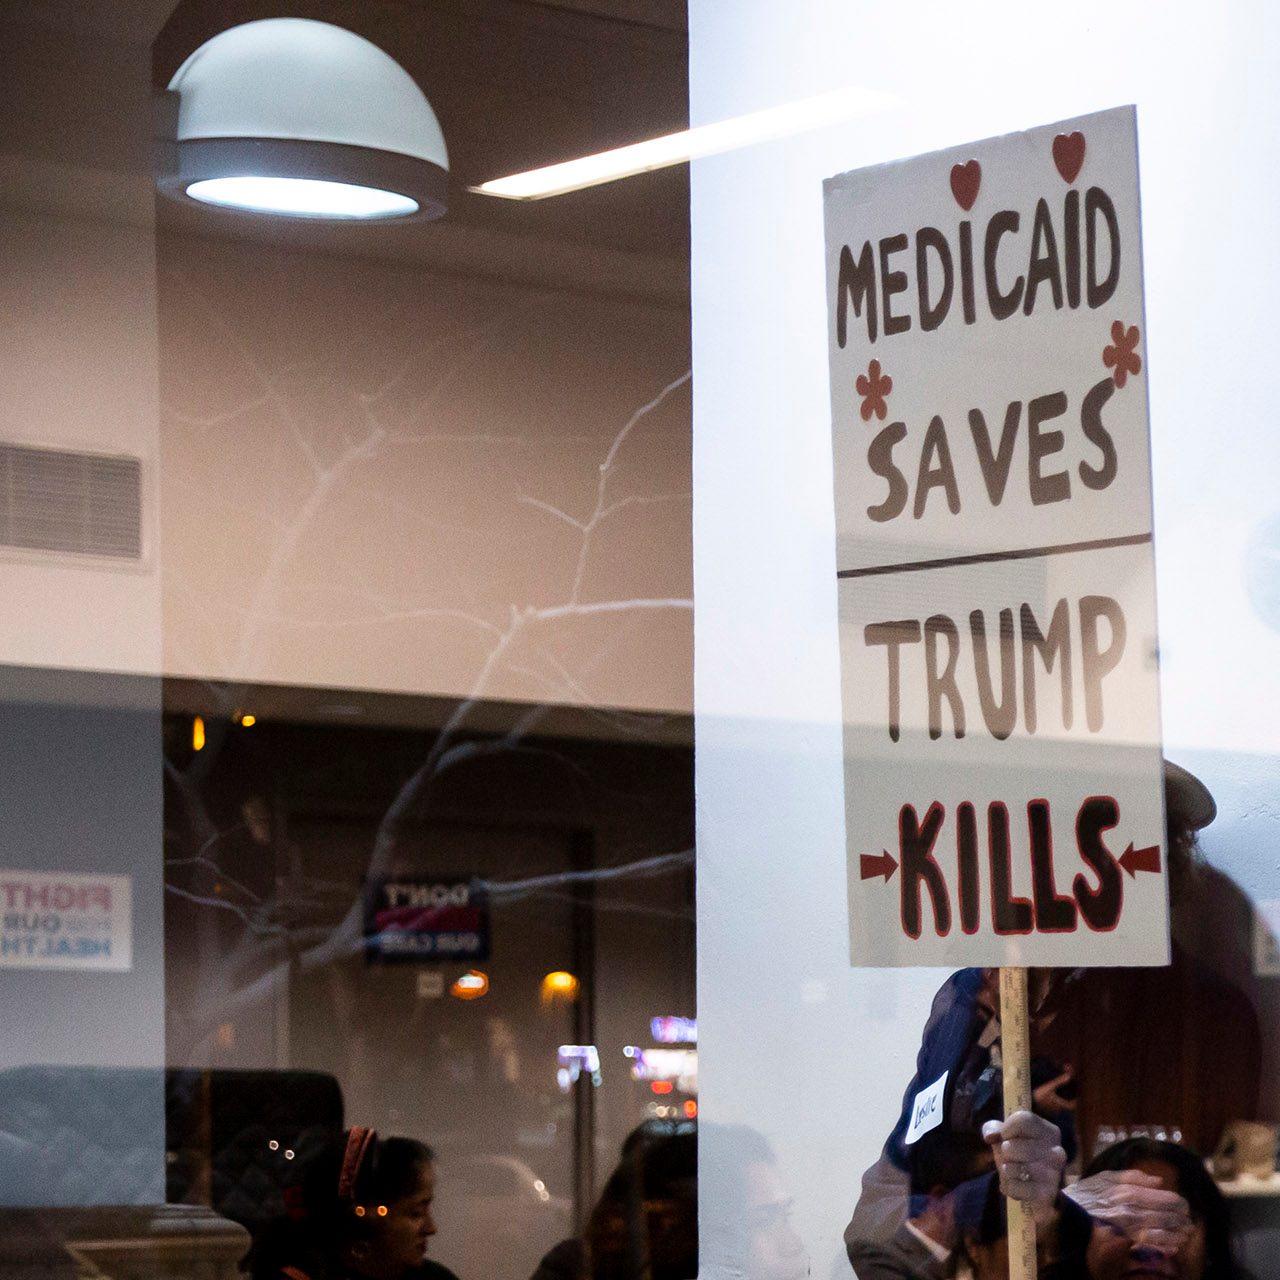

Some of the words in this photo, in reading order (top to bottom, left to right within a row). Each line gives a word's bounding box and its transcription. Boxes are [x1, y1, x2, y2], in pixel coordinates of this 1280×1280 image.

[836, 186, 1121, 348] MEDICAID
[866, 377, 1118, 523] SAVES
[864, 595, 1127, 743] TRUMP
[898, 795, 1125, 940] KILLS
